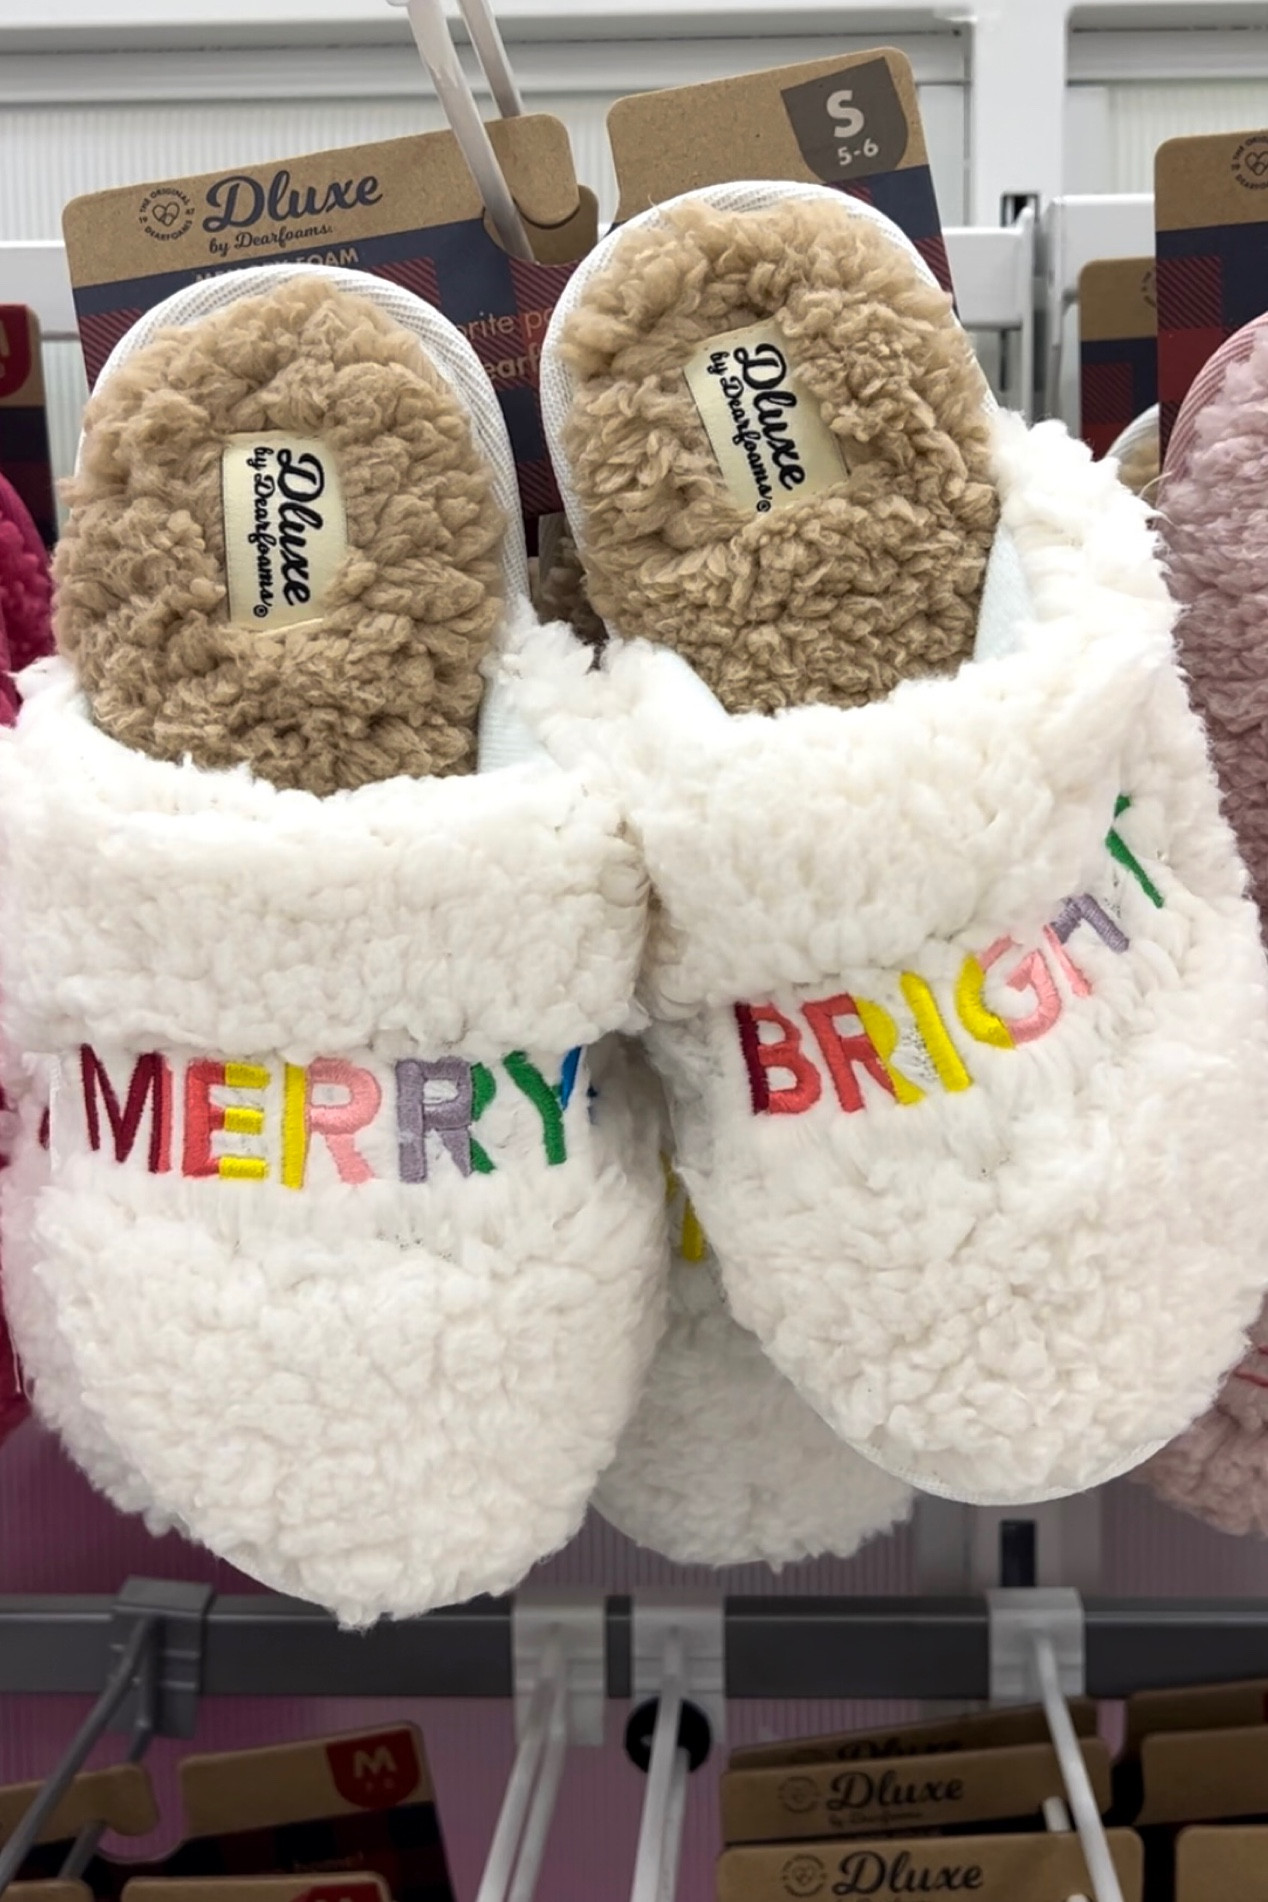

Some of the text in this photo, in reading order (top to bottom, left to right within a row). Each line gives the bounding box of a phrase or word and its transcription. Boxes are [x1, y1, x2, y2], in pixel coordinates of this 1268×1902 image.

[826, 89, 865, 138] S
[837, 138, 879, 166] 5-6
[202, 170, 383, 233] Dluxe
[208, 237, 231, 257] by
[706, 351, 730, 376] by
[733, 342, 805, 491] Dluxe
[246, 446, 274, 471] by
[276, 448, 325, 606] Dluxe
[80, 1042, 583, 1190] MERRY
[353, 1744, 397, 1780] M
[827, 1770, 964, 1811] Dluxe
[832, 1850, 983, 1895] Dluxe
